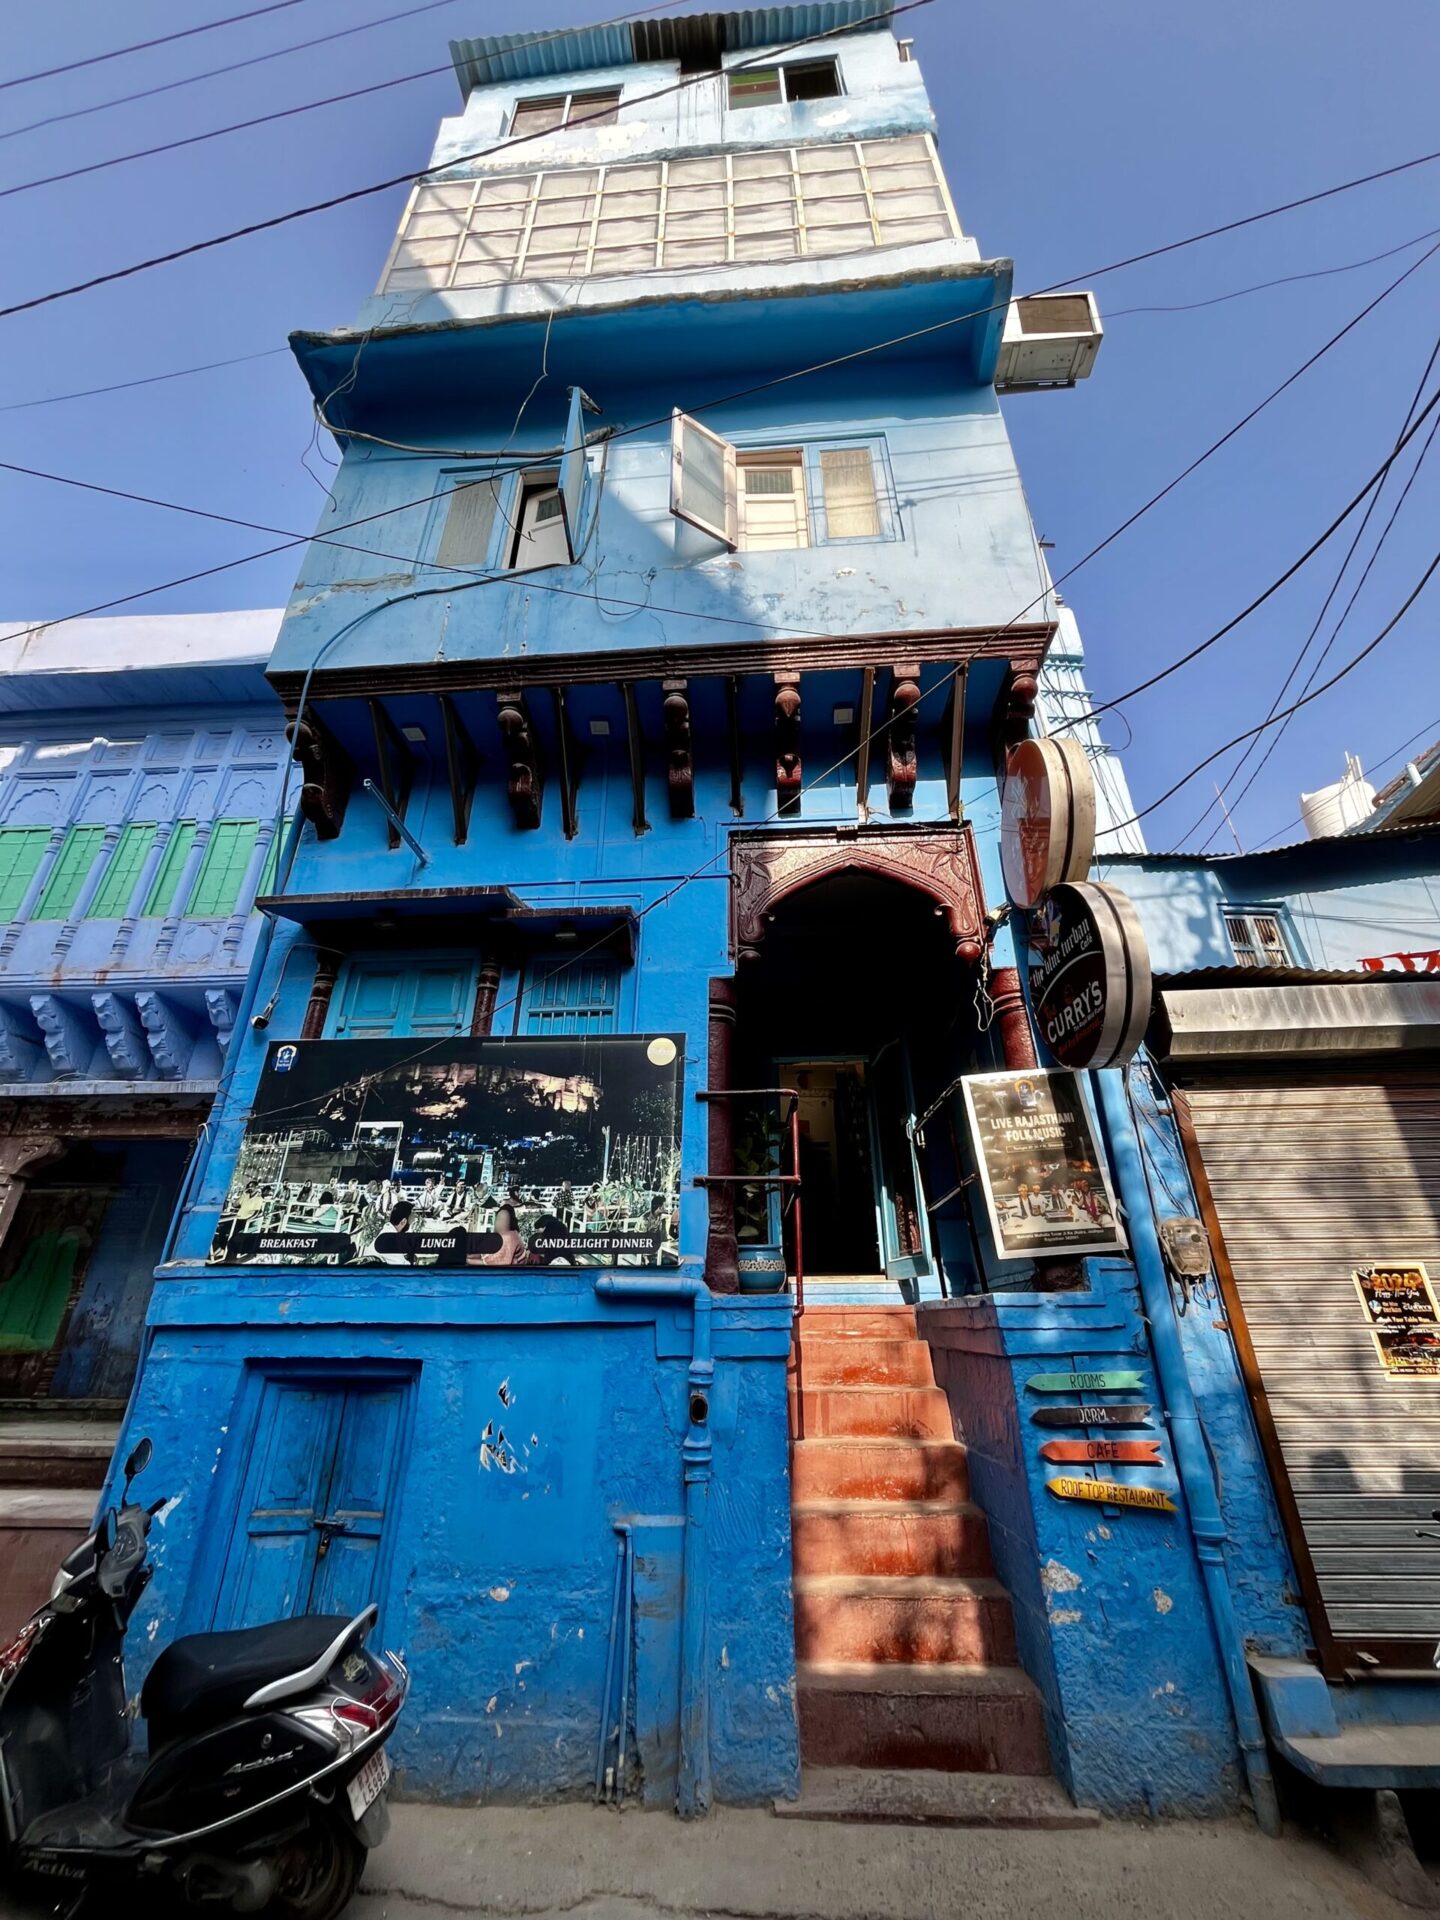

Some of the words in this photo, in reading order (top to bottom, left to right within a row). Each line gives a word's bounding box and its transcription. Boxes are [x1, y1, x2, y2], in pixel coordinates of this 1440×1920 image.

[1060, 918, 1090, 957] turban
[1047, 980, 1102, 1043] CURRY'S
[991, 1117, 1012, 1129] LIVE
[1015, 1112, 1075, 1127] RAJASTHANI
[1006, 1130, 1033, 1142] FOLK
[1033, 1126, 1066, 1140] MUSIC
[259, 1238, 318, 1248] BREAKFAST
[420, 1238, 456, 1248] LUNCH
[535, 1238, 610, 1248] CANDLELIGHT
[611, 1238, 654, 1248] DINNER
[1069, 1374, 1106, 1389] ROOMS
[1061, 1478, 1084, 1497] ROOF
[1084, 1482, 1105, 1499] TOP
[1106, 1484, 1165, 1507] RESTAURANT
